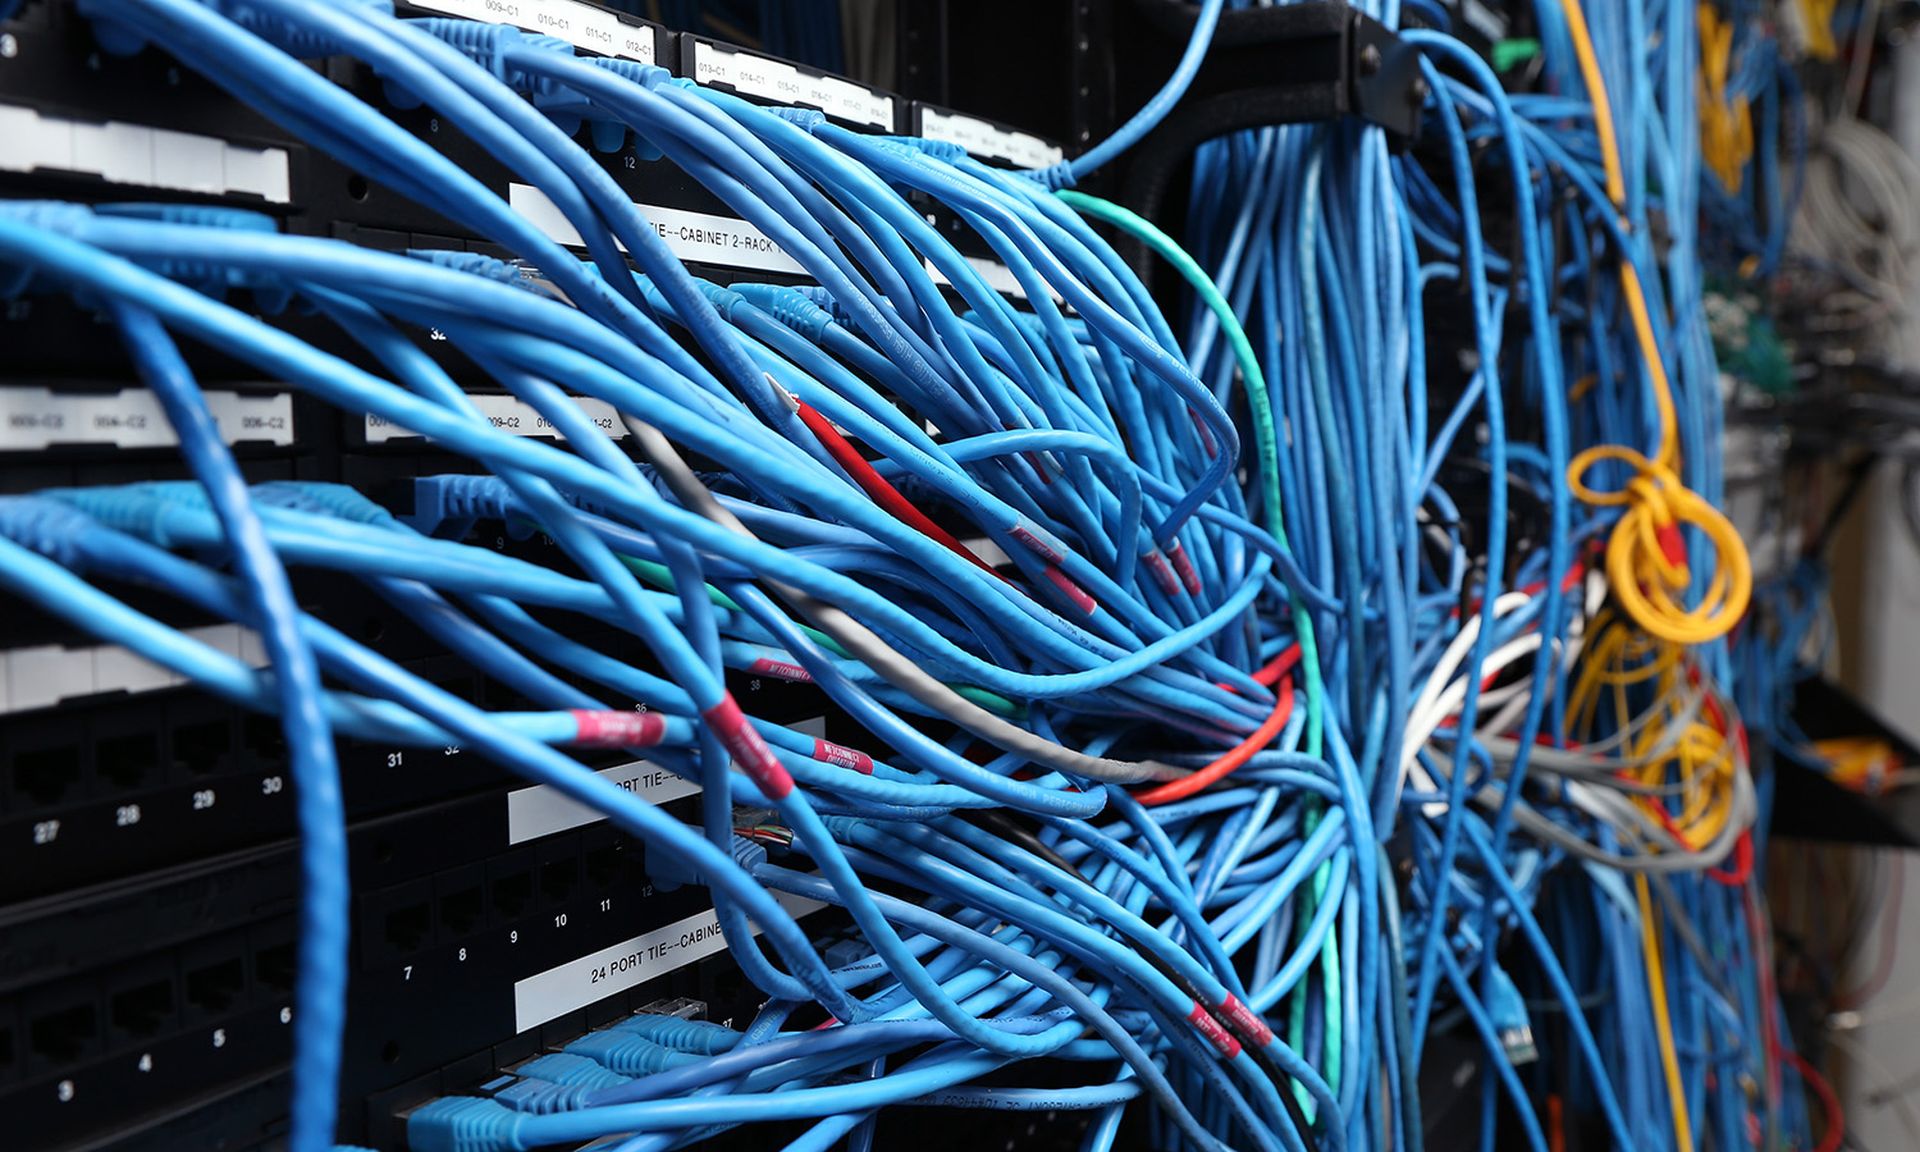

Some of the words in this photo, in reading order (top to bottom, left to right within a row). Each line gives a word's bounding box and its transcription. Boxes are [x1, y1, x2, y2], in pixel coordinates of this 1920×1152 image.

[537, 13, 569, 30] 010-C1
[585, 26, 612, 43] 011-C1
[625, 39, 651, 55] 012-C1
[699, 62, 726, 76] 013-C1
[430, 118, 439, 132] 8
[624, 155, 636, 169] 12
[732, 234, 774, 253] 2-RACK
[593, 418, 613, 429] 1-C2
[496, 537, 505, 549] 9
[635, 703, 648, 715] 36
[387, 751, 403, 768] 31
[116, 804, 141, 826] 28
[193, 789, 216, 809] 29
[262, 776, 283, 795] 30
[404, 965, 413, 980] 7
[458, 948, 467, 961] 8
[510, 930, 518, 943] 9
[554, 914, 568, 928] 10
[600, 898, 612, 912] 11
[641, 885, 653, 898] 12
[590, 966, 606, 984] 24
[610, 951, 644, 976] PORT
[647, 921, 722, 961] TIE--CABINE
[58, 1080, 74, 1102] 3
[138, 1053, 152, 1073] 4
[213, 1028, 226, 1048] 5
[280, 1006, 291, 1024] 6
